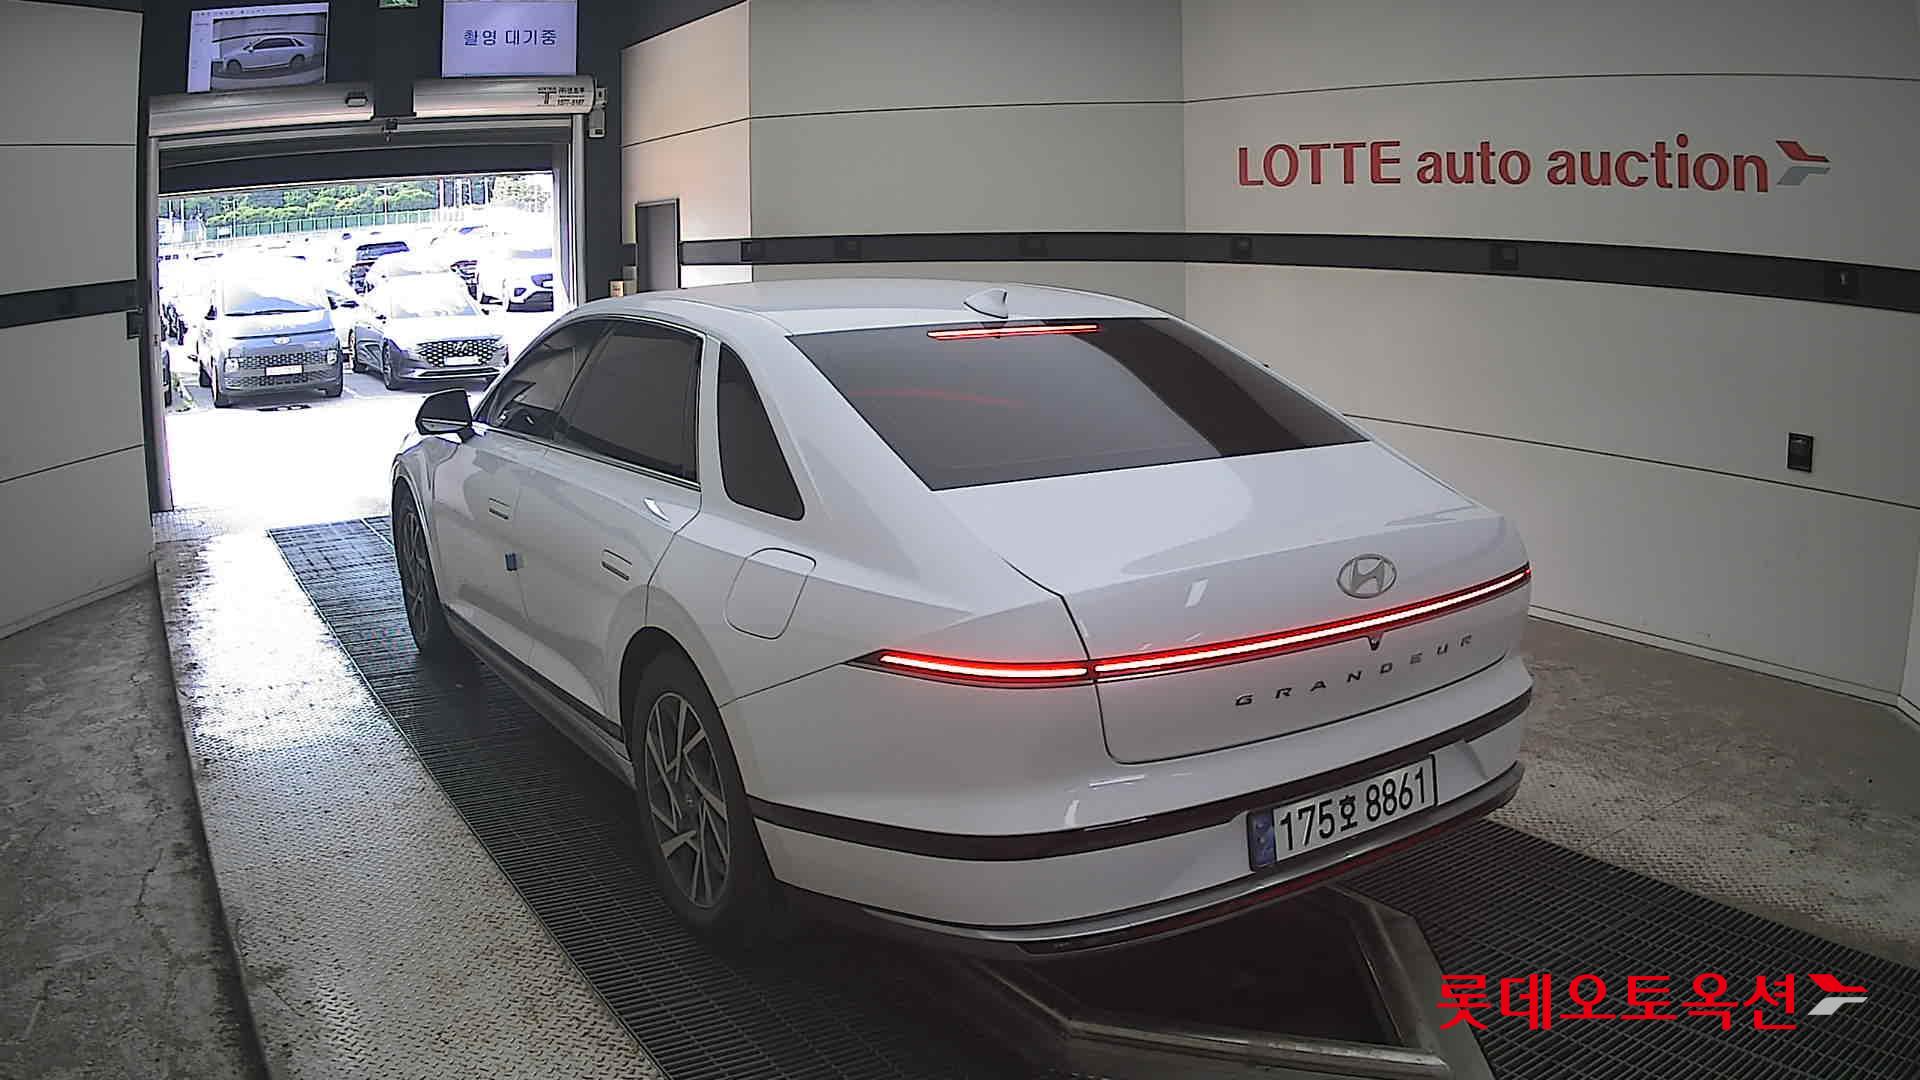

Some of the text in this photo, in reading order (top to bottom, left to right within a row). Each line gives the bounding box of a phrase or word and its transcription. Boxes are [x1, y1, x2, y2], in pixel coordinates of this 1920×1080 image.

[505, 28, 558, 47] 대기중
[1238, 133, 1768, 192] LOTTE auto auction
[1235, 634, 1473, 706] GRANDEUR
[1279, 766, 1426, 852] 175호 8861
